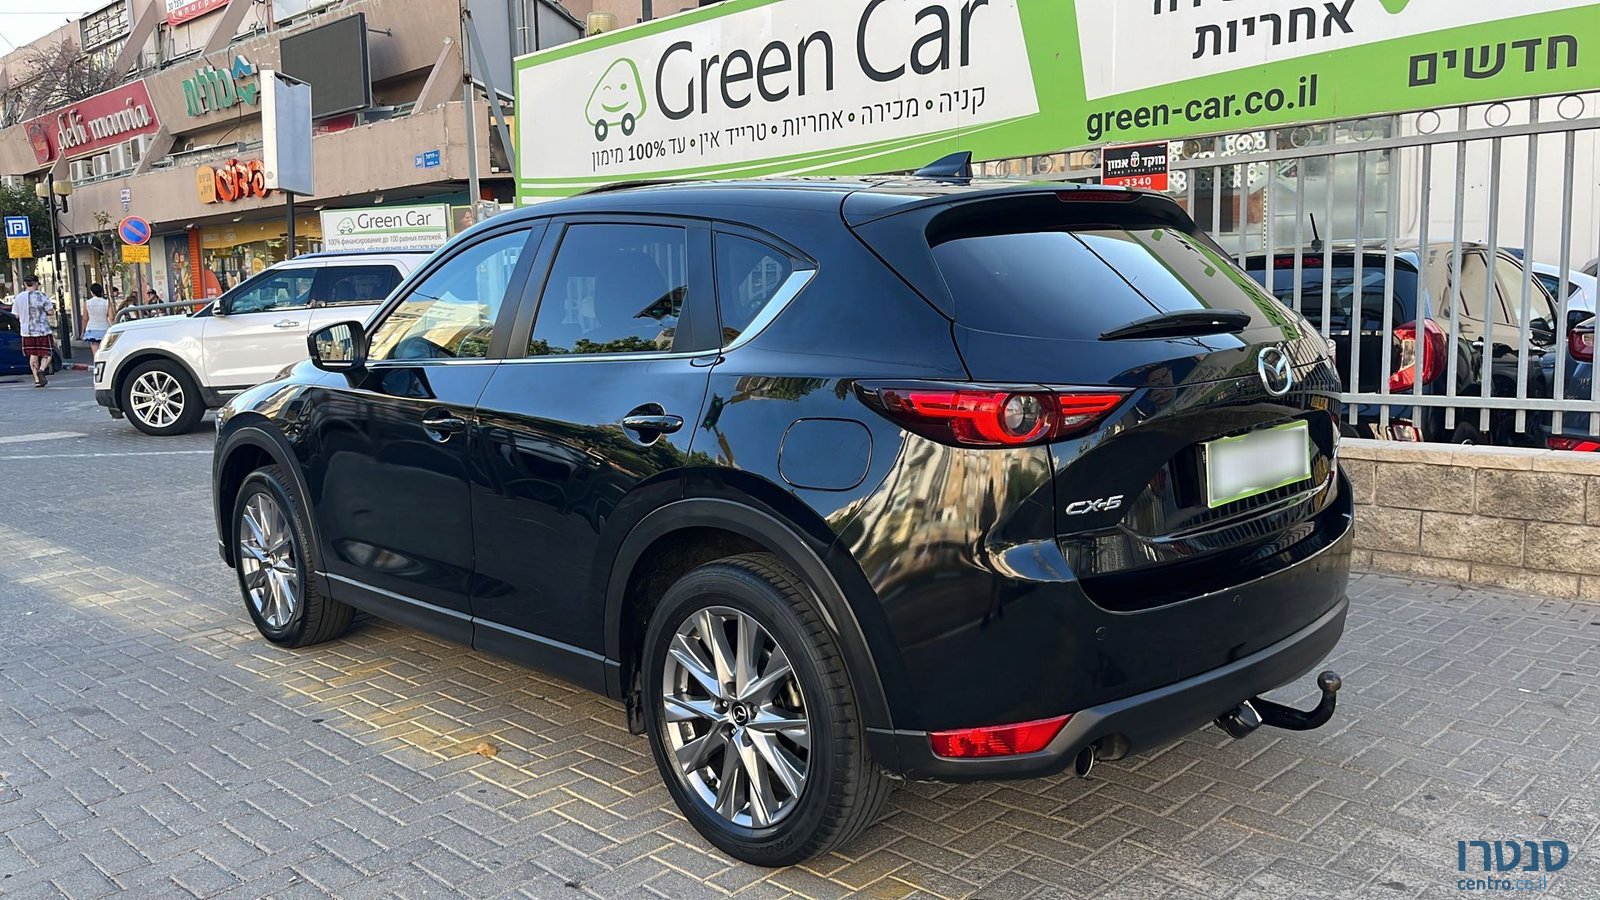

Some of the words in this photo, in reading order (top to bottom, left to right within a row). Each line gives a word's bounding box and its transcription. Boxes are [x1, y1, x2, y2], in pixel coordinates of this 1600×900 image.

[1192, 0, 1355, 59] אחריות
[655, 31, 834, 120] Green
[857, 0, 988, 82] Car
[1408, 34, 1578, 87] חדשים
[861, 97, 919, 125] מכירה
[939, 86, 986, 115] קניה
[1086, 74, 1318, 141] green-car.co.il
[58, 108, 89, 150] deli
[725, 123, 767, 145] טרייד
[781, 109, 844, 137] אחריות
[628, 140, 666, 161] 100%
[668, 136, 686, 154] עד
[699, 130, 720, 155] אין
[591, 147, 624, 172] מימון
[1106, 159, 1129, 171] אמון
[1141, 155, 1166, 167] מוקד
[357, 213, 402, 229] Green
[405, 211, 431, 227] Car
[1065, 494, 1124, 516] CX-5
